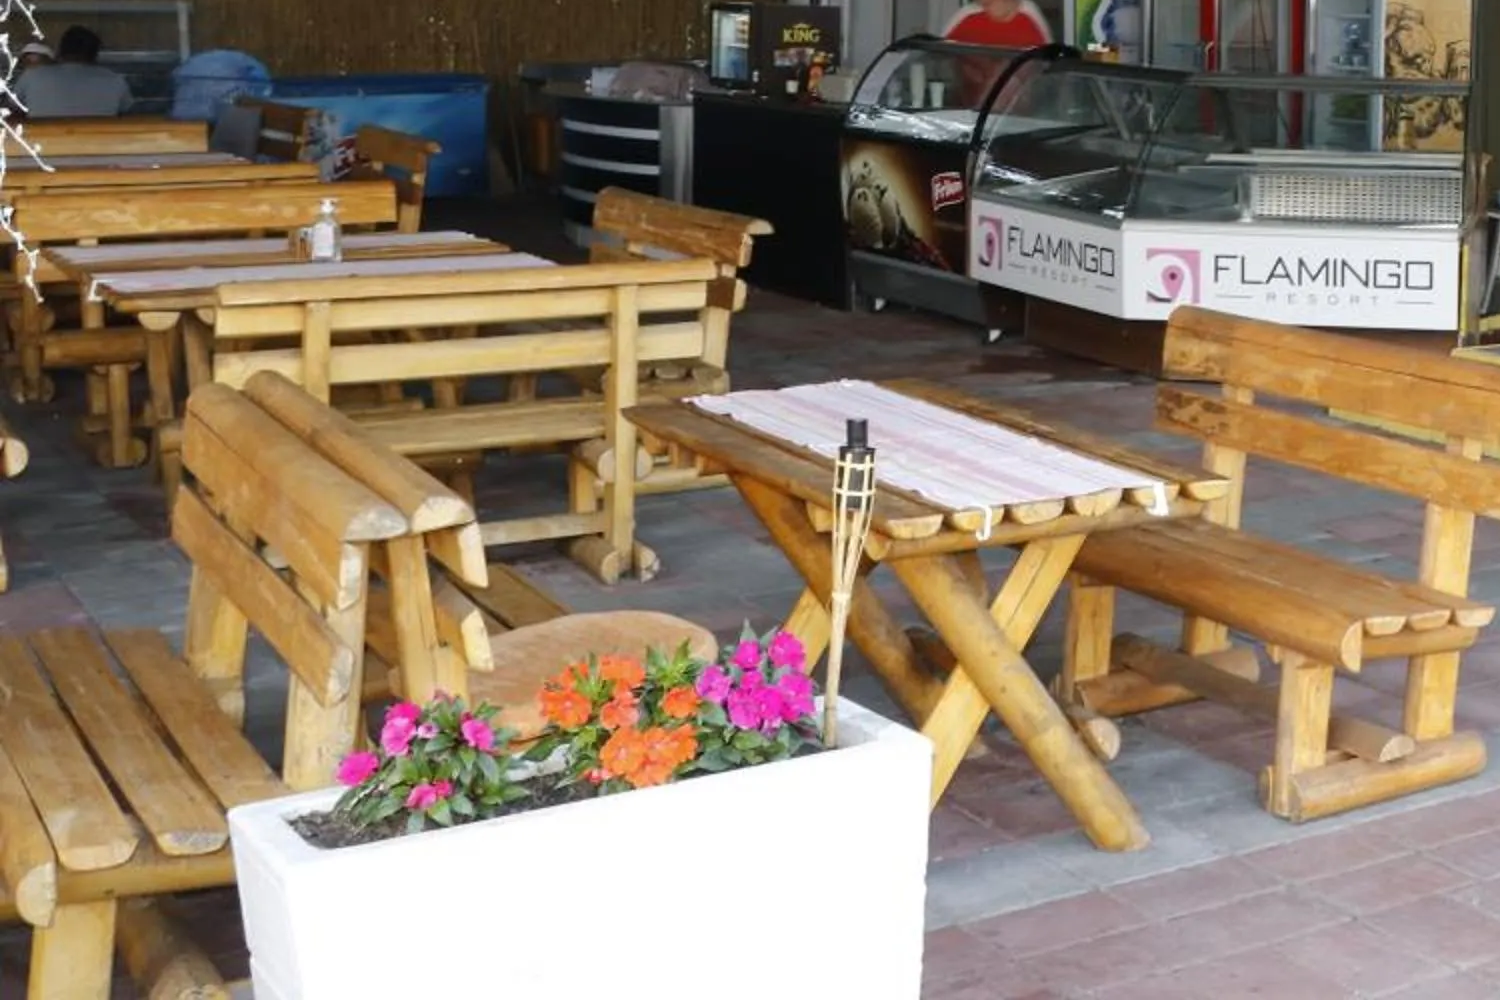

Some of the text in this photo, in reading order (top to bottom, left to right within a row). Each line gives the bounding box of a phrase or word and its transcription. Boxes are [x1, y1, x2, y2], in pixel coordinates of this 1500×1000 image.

[783, 28, 821, 43] KING
[1007, 225, 1115, 278] FLAMINGO
[1031, 264, 1088, 287] RESORT
[1213, 254, 1434, 290] FLAMINGO
[1265, 293, 1380, 306] RESORT
